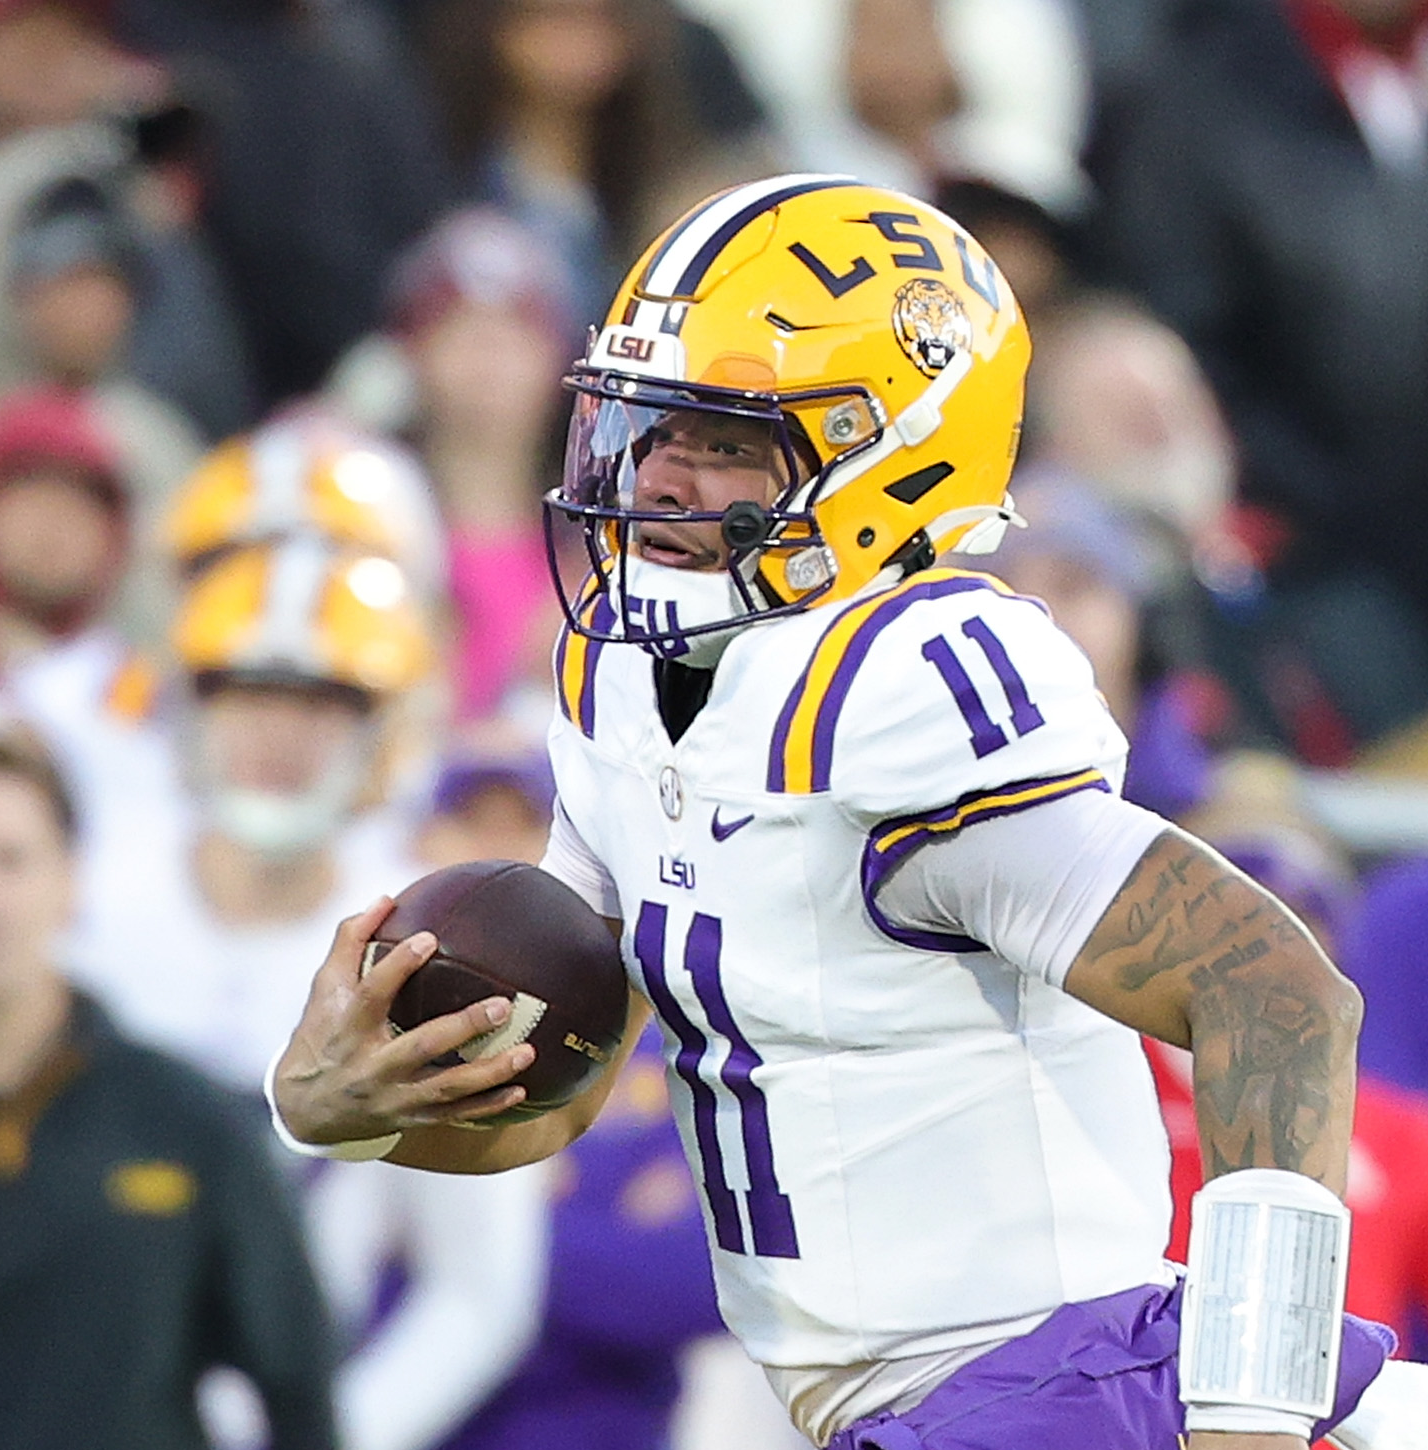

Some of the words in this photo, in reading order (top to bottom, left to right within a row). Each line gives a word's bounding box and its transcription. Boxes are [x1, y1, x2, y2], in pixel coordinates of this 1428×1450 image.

[787, 211, 999, 312] LSU
[607, 333, 655, 363] LSU
[922, 616, 1045, 758] 11
[659, 855, 695, 889] LSU
[634, 900, 800, 1258] 11
